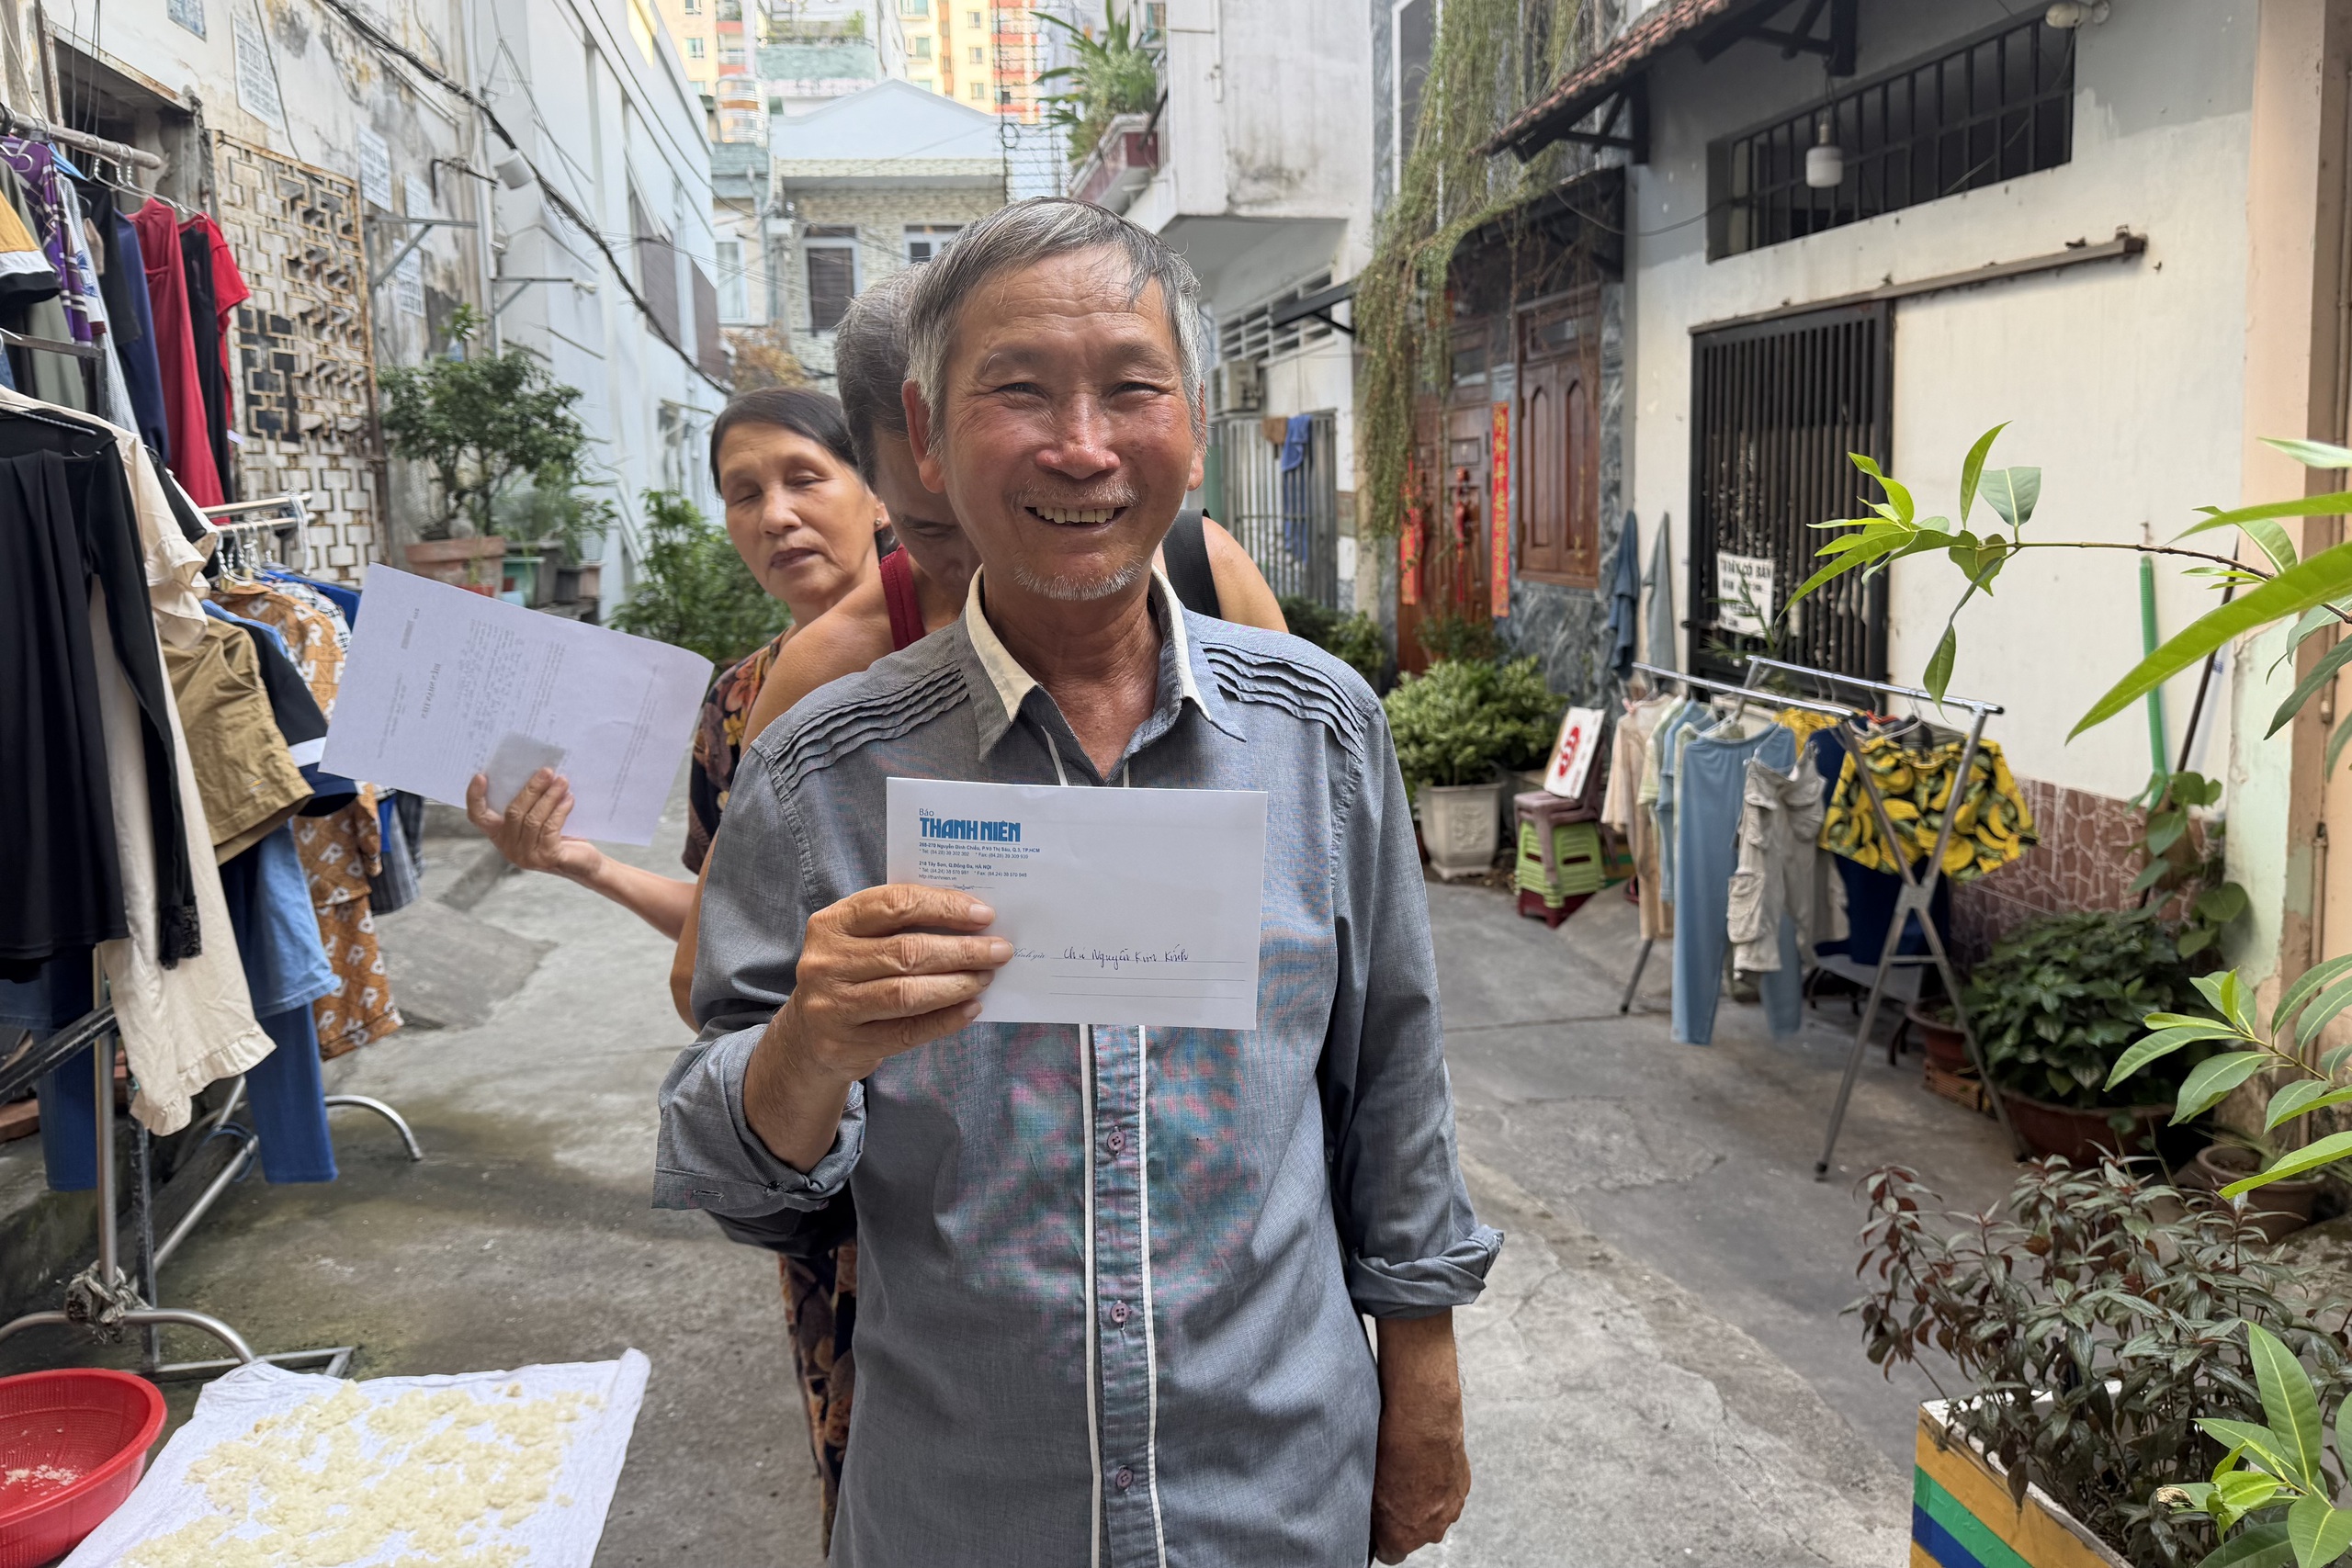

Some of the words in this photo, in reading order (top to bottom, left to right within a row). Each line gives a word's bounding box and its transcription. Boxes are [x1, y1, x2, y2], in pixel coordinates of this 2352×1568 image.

[919, 808, 934, 817] Báo
[920, 817, 978, 840] THANH
[980, 819, 1021, 842] NIÊN
